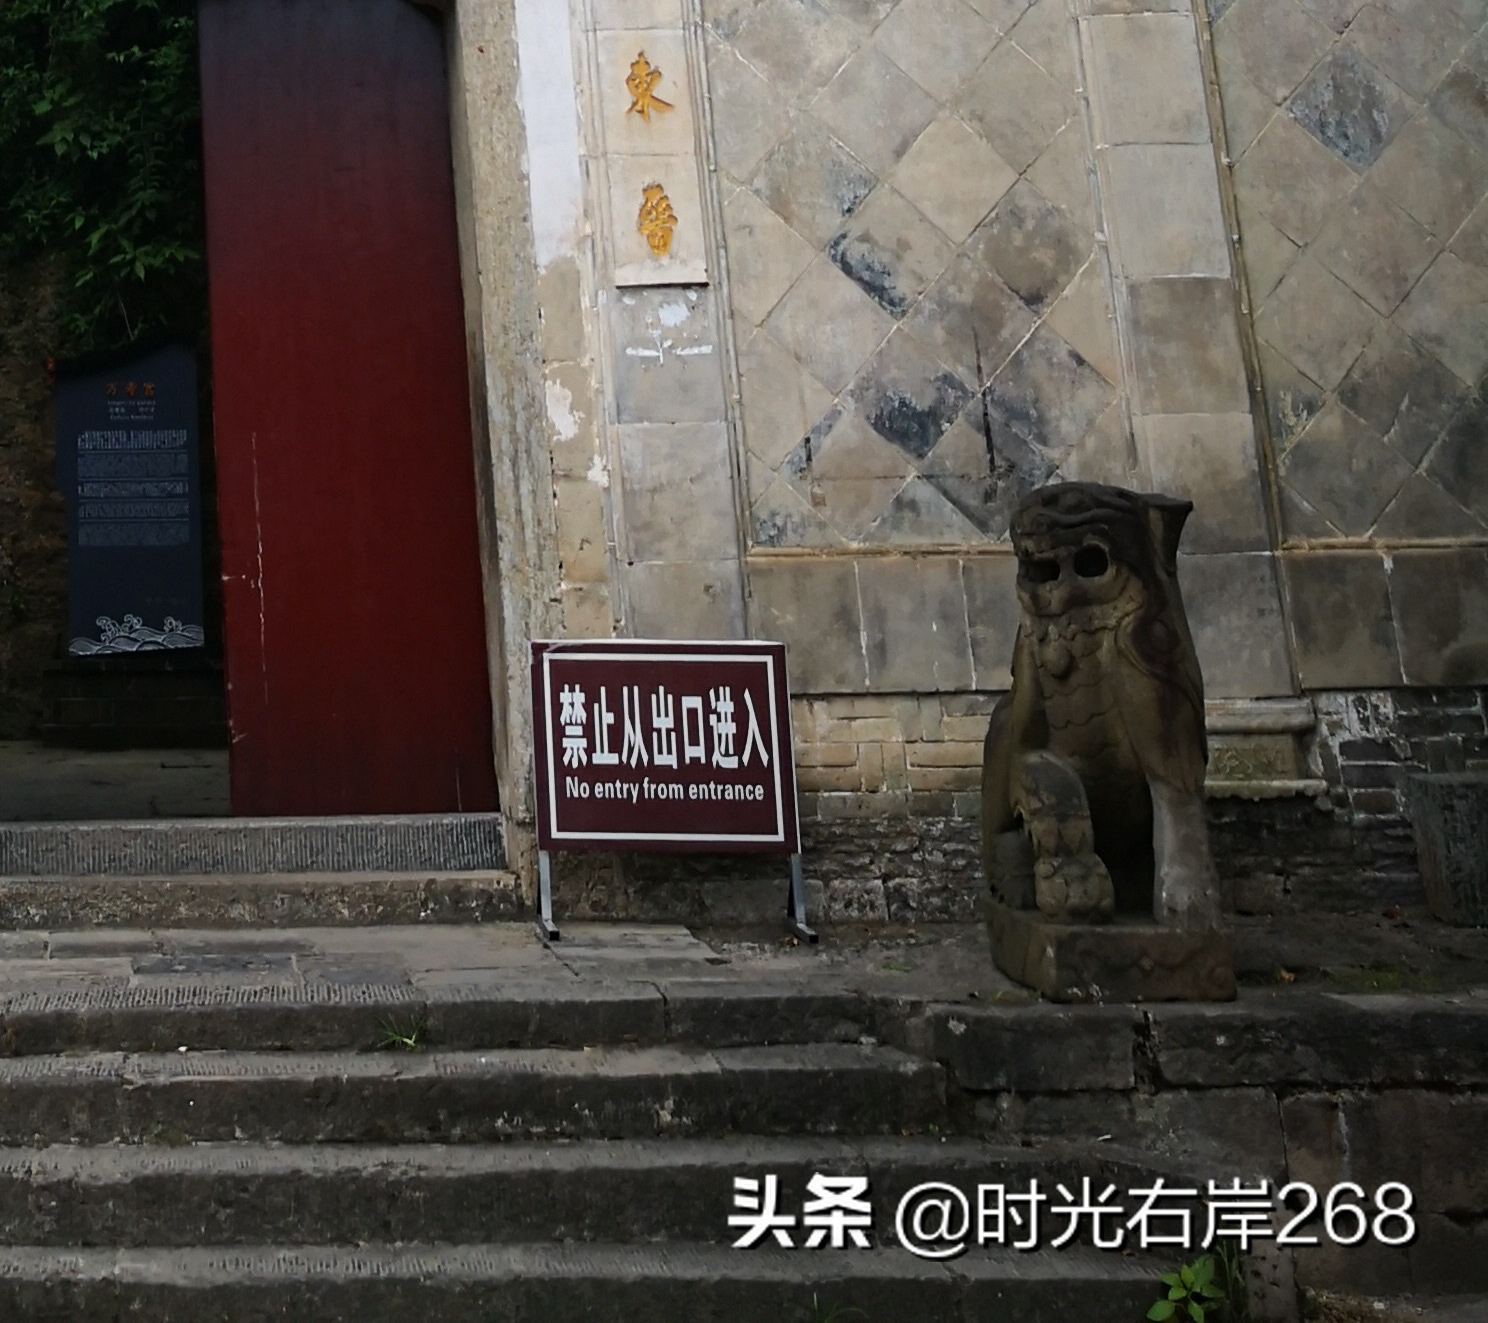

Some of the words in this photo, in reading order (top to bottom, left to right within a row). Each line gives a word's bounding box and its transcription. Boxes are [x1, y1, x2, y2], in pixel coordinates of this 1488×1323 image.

[559, 684, 770, 769] 禁止从出口进入
[566, 776, 589, 799] No
[594, 780, 639, 804] entry
[643, 777, 684, 800] from
[689, 781, 765, 801] entrance
